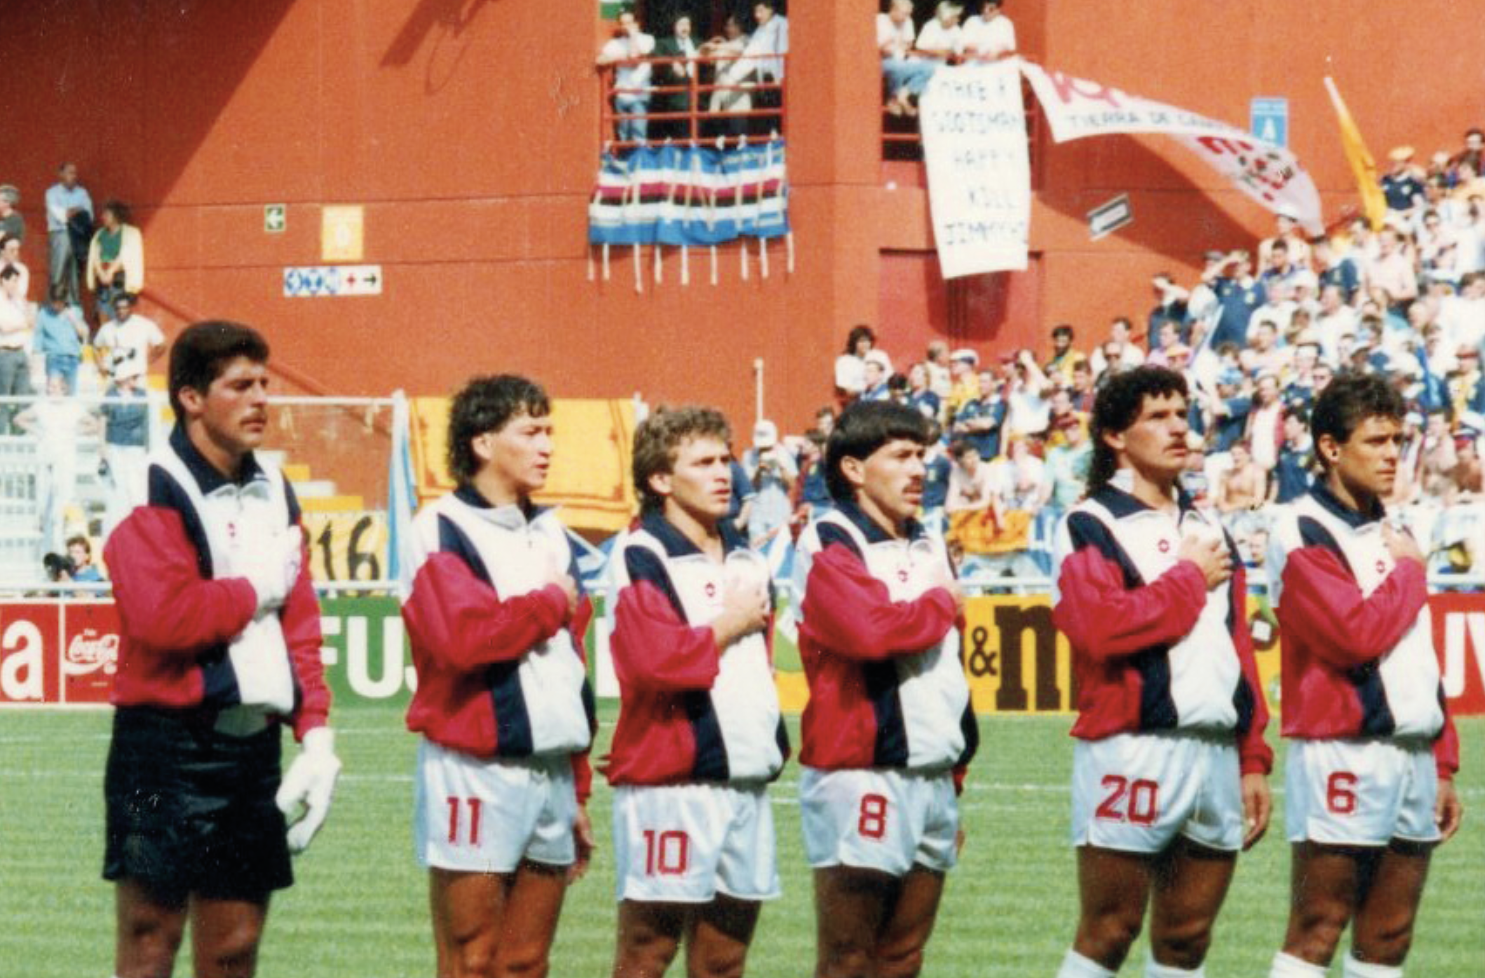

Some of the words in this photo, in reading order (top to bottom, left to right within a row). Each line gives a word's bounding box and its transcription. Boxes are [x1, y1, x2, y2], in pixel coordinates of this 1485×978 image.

[858, 793, 888, 839] 8
[1095, 773, 1159, 825] 20
[1326, 771, 1359, 815] 6
[446, 795, 482, 845] 11
[643, 829, 689, 877] 10
